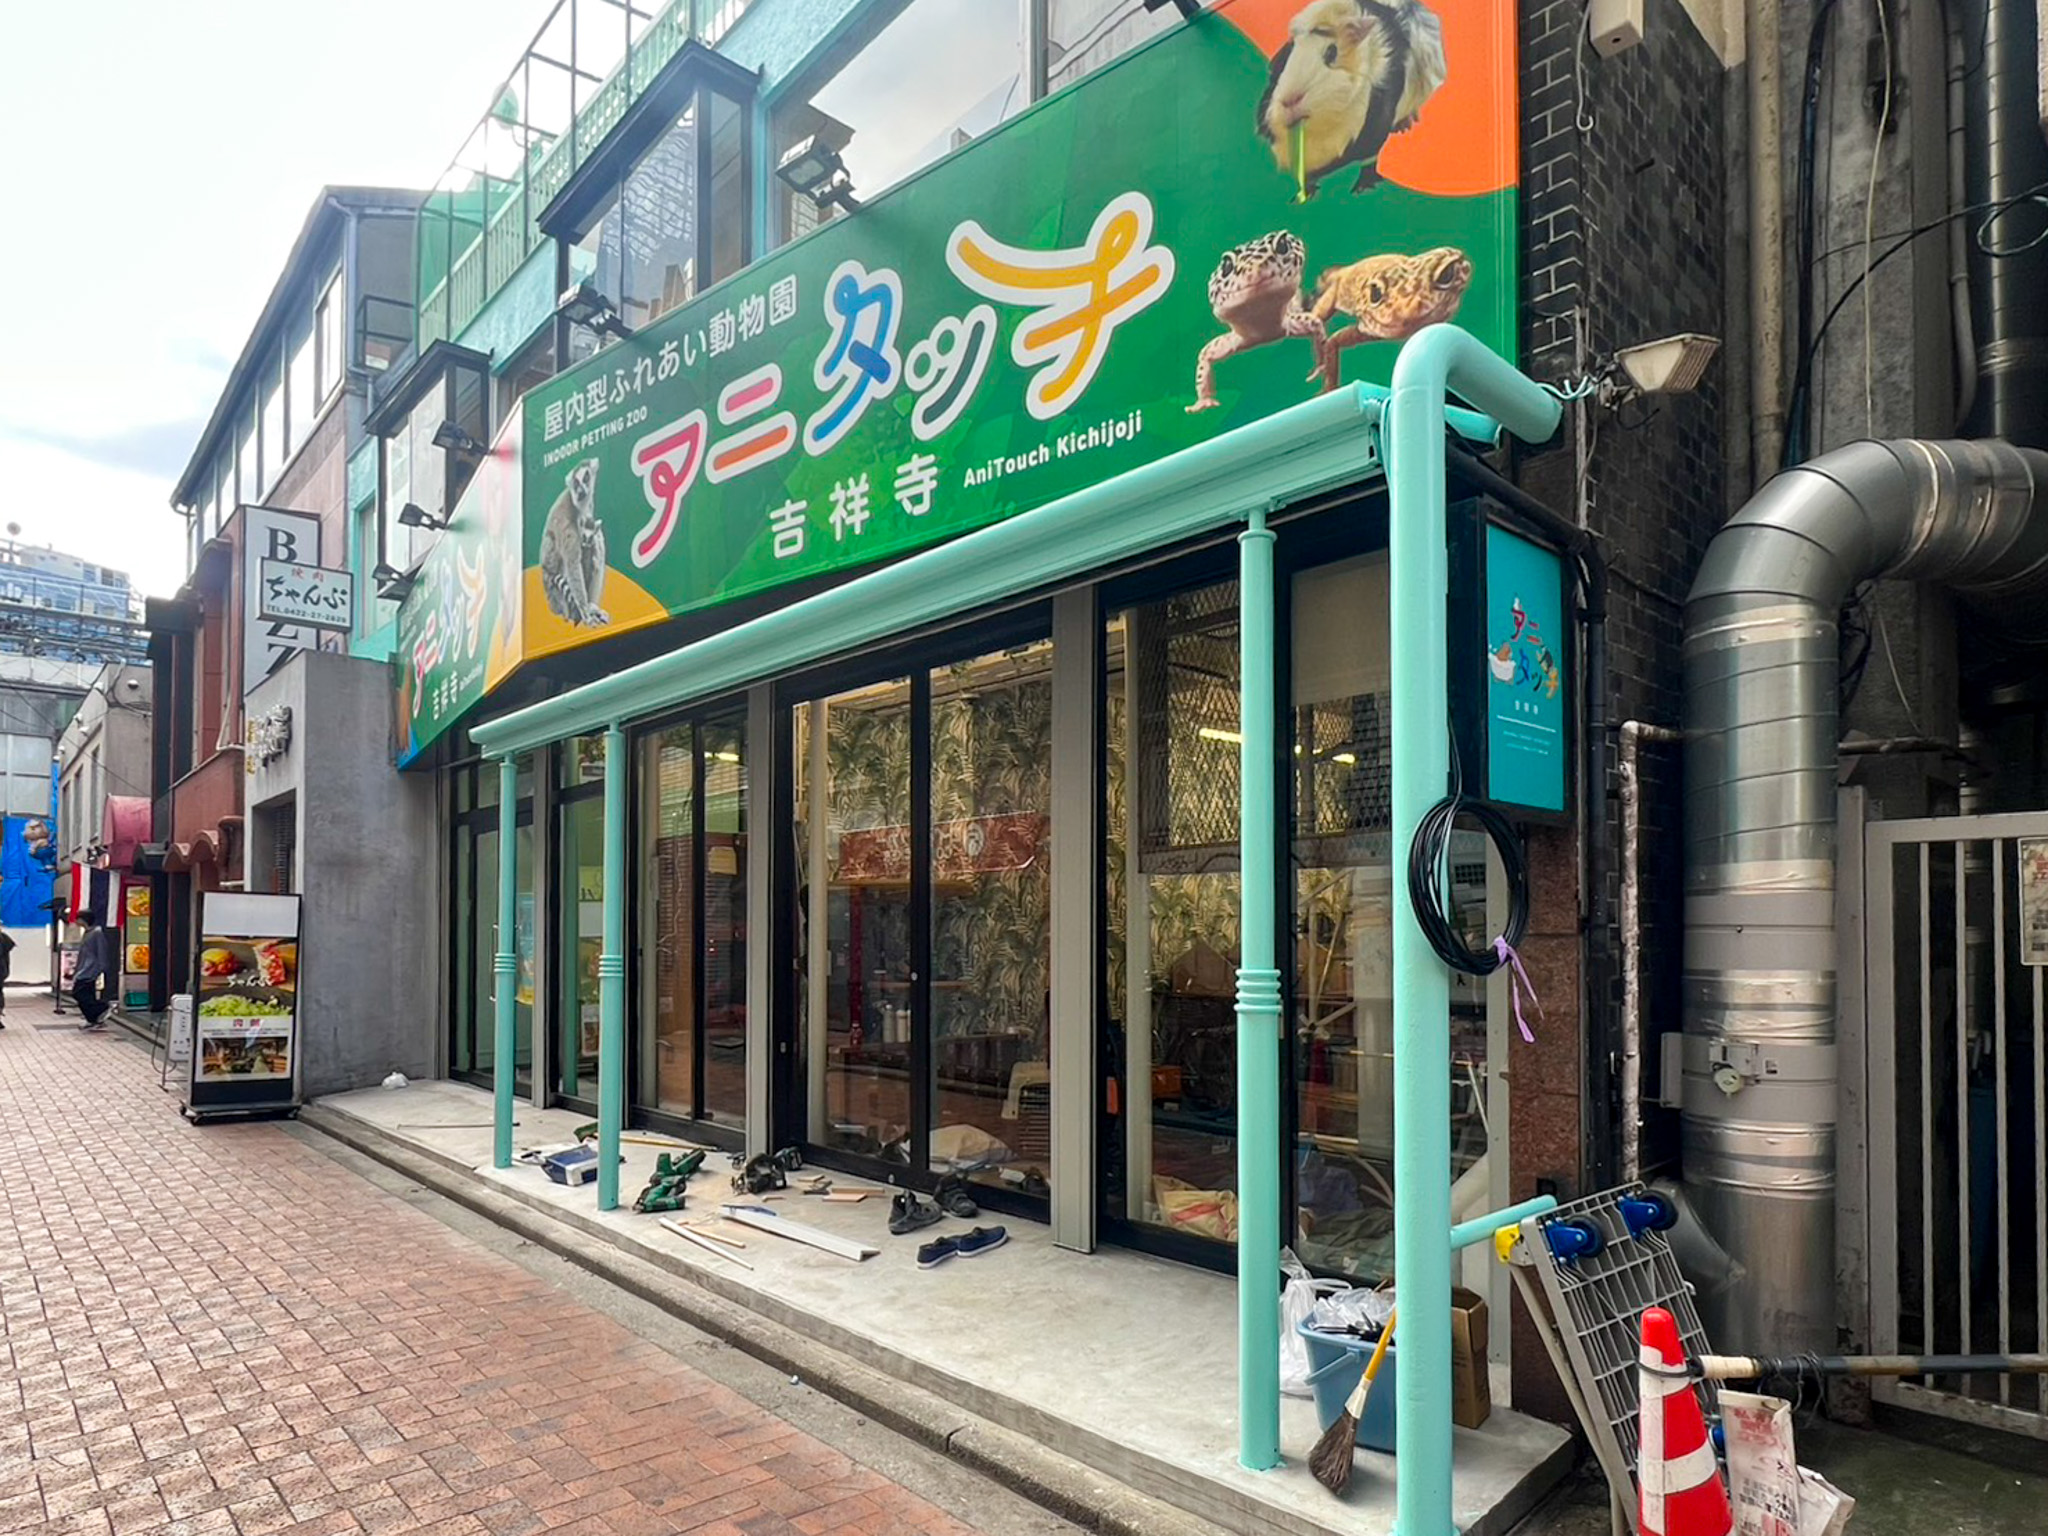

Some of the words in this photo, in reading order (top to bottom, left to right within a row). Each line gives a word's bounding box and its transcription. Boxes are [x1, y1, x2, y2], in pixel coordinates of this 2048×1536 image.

[544, 273, 797, 442] 屋内型ふれあい動物園
[631, 191, 1176, 568] アニタッチ
[543, 438, 580, 468] INDOOR
[581, 417, 624, 449] PETTING
[626, 405, 648, 428] ZOO
[963, 443, 1050, 488] AniTouch
[1056, 409, 1142, 459] Kichijoji
[769, 453, 938, 559] 吉祥寺
[265, 575, 348, 610] ちゃんぷ
